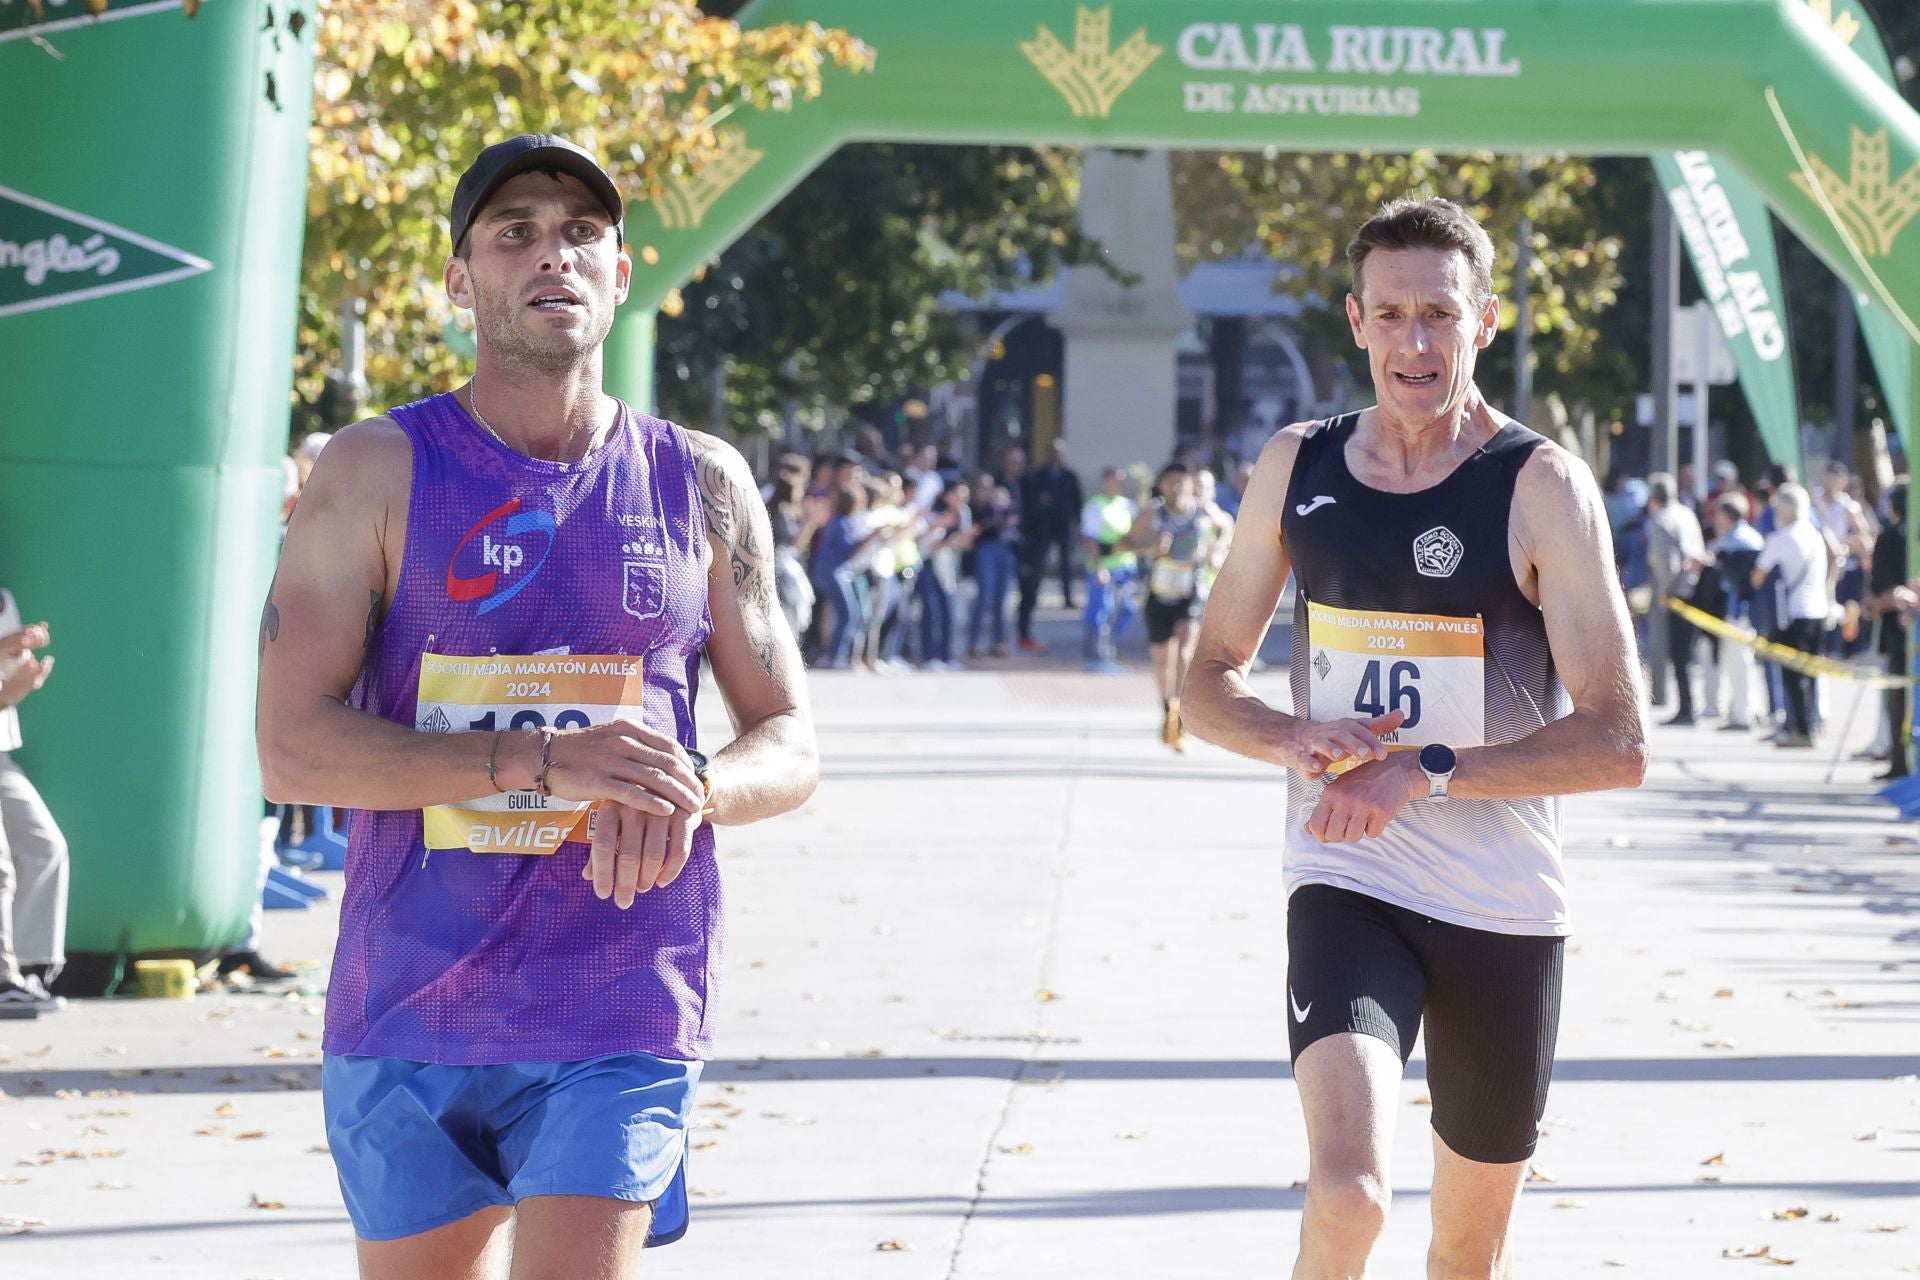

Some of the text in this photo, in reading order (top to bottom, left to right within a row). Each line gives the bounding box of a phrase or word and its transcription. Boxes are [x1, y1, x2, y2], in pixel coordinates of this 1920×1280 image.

[1177, 22, 1521, 76] CAJA RURAL
[1183, 81, 1421, 117] DE ASTURIAS
[483, 535, 524, 574] kp
[1338, 616, 1371, 629] MEDIA
[1373, 618, 1434, 632] MARATÓN
[1436, 619, 1479, 634] AVILÉS
[1367, 635, 1406, 650] 2024
[473, 663, 512, 676] MEDIA
[514, 658, 586, 675] MARATÓN
[589, 659, 638, 677] AVILÉS
[505, 682, 551, 698] 2024
[1354, 660, 1422, 729] 46
[508, 794, 548, 810] GUILLE
